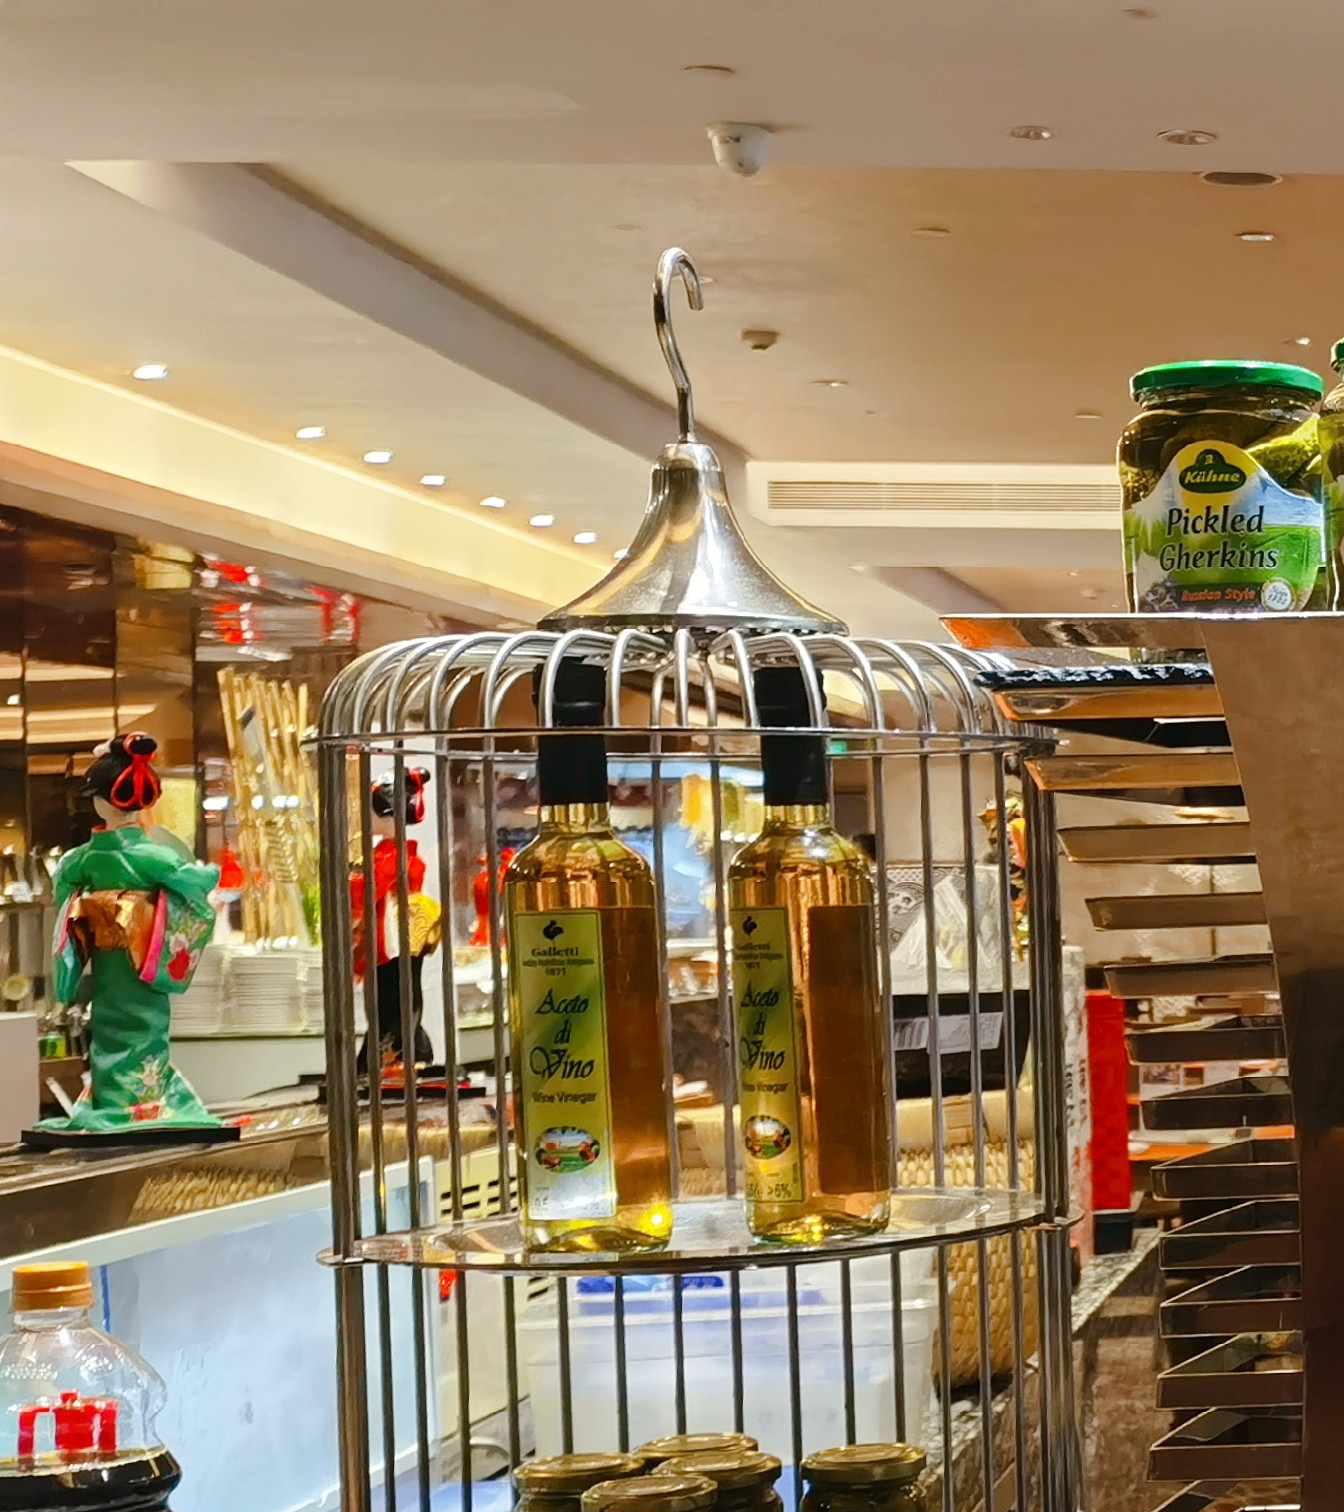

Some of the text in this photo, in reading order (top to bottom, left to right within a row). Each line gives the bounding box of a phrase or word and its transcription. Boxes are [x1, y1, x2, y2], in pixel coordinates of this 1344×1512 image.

[1167, 505, 1264, 536] Pickled
[1160, 541, 1278, 571] Gherkins
[534, 988, 590, 1014] Aceto
[553, 1019, 572, 1044] di
[530, 1046, 596, 1079] Vino
[739, 1036, 786, 1070] Vino
